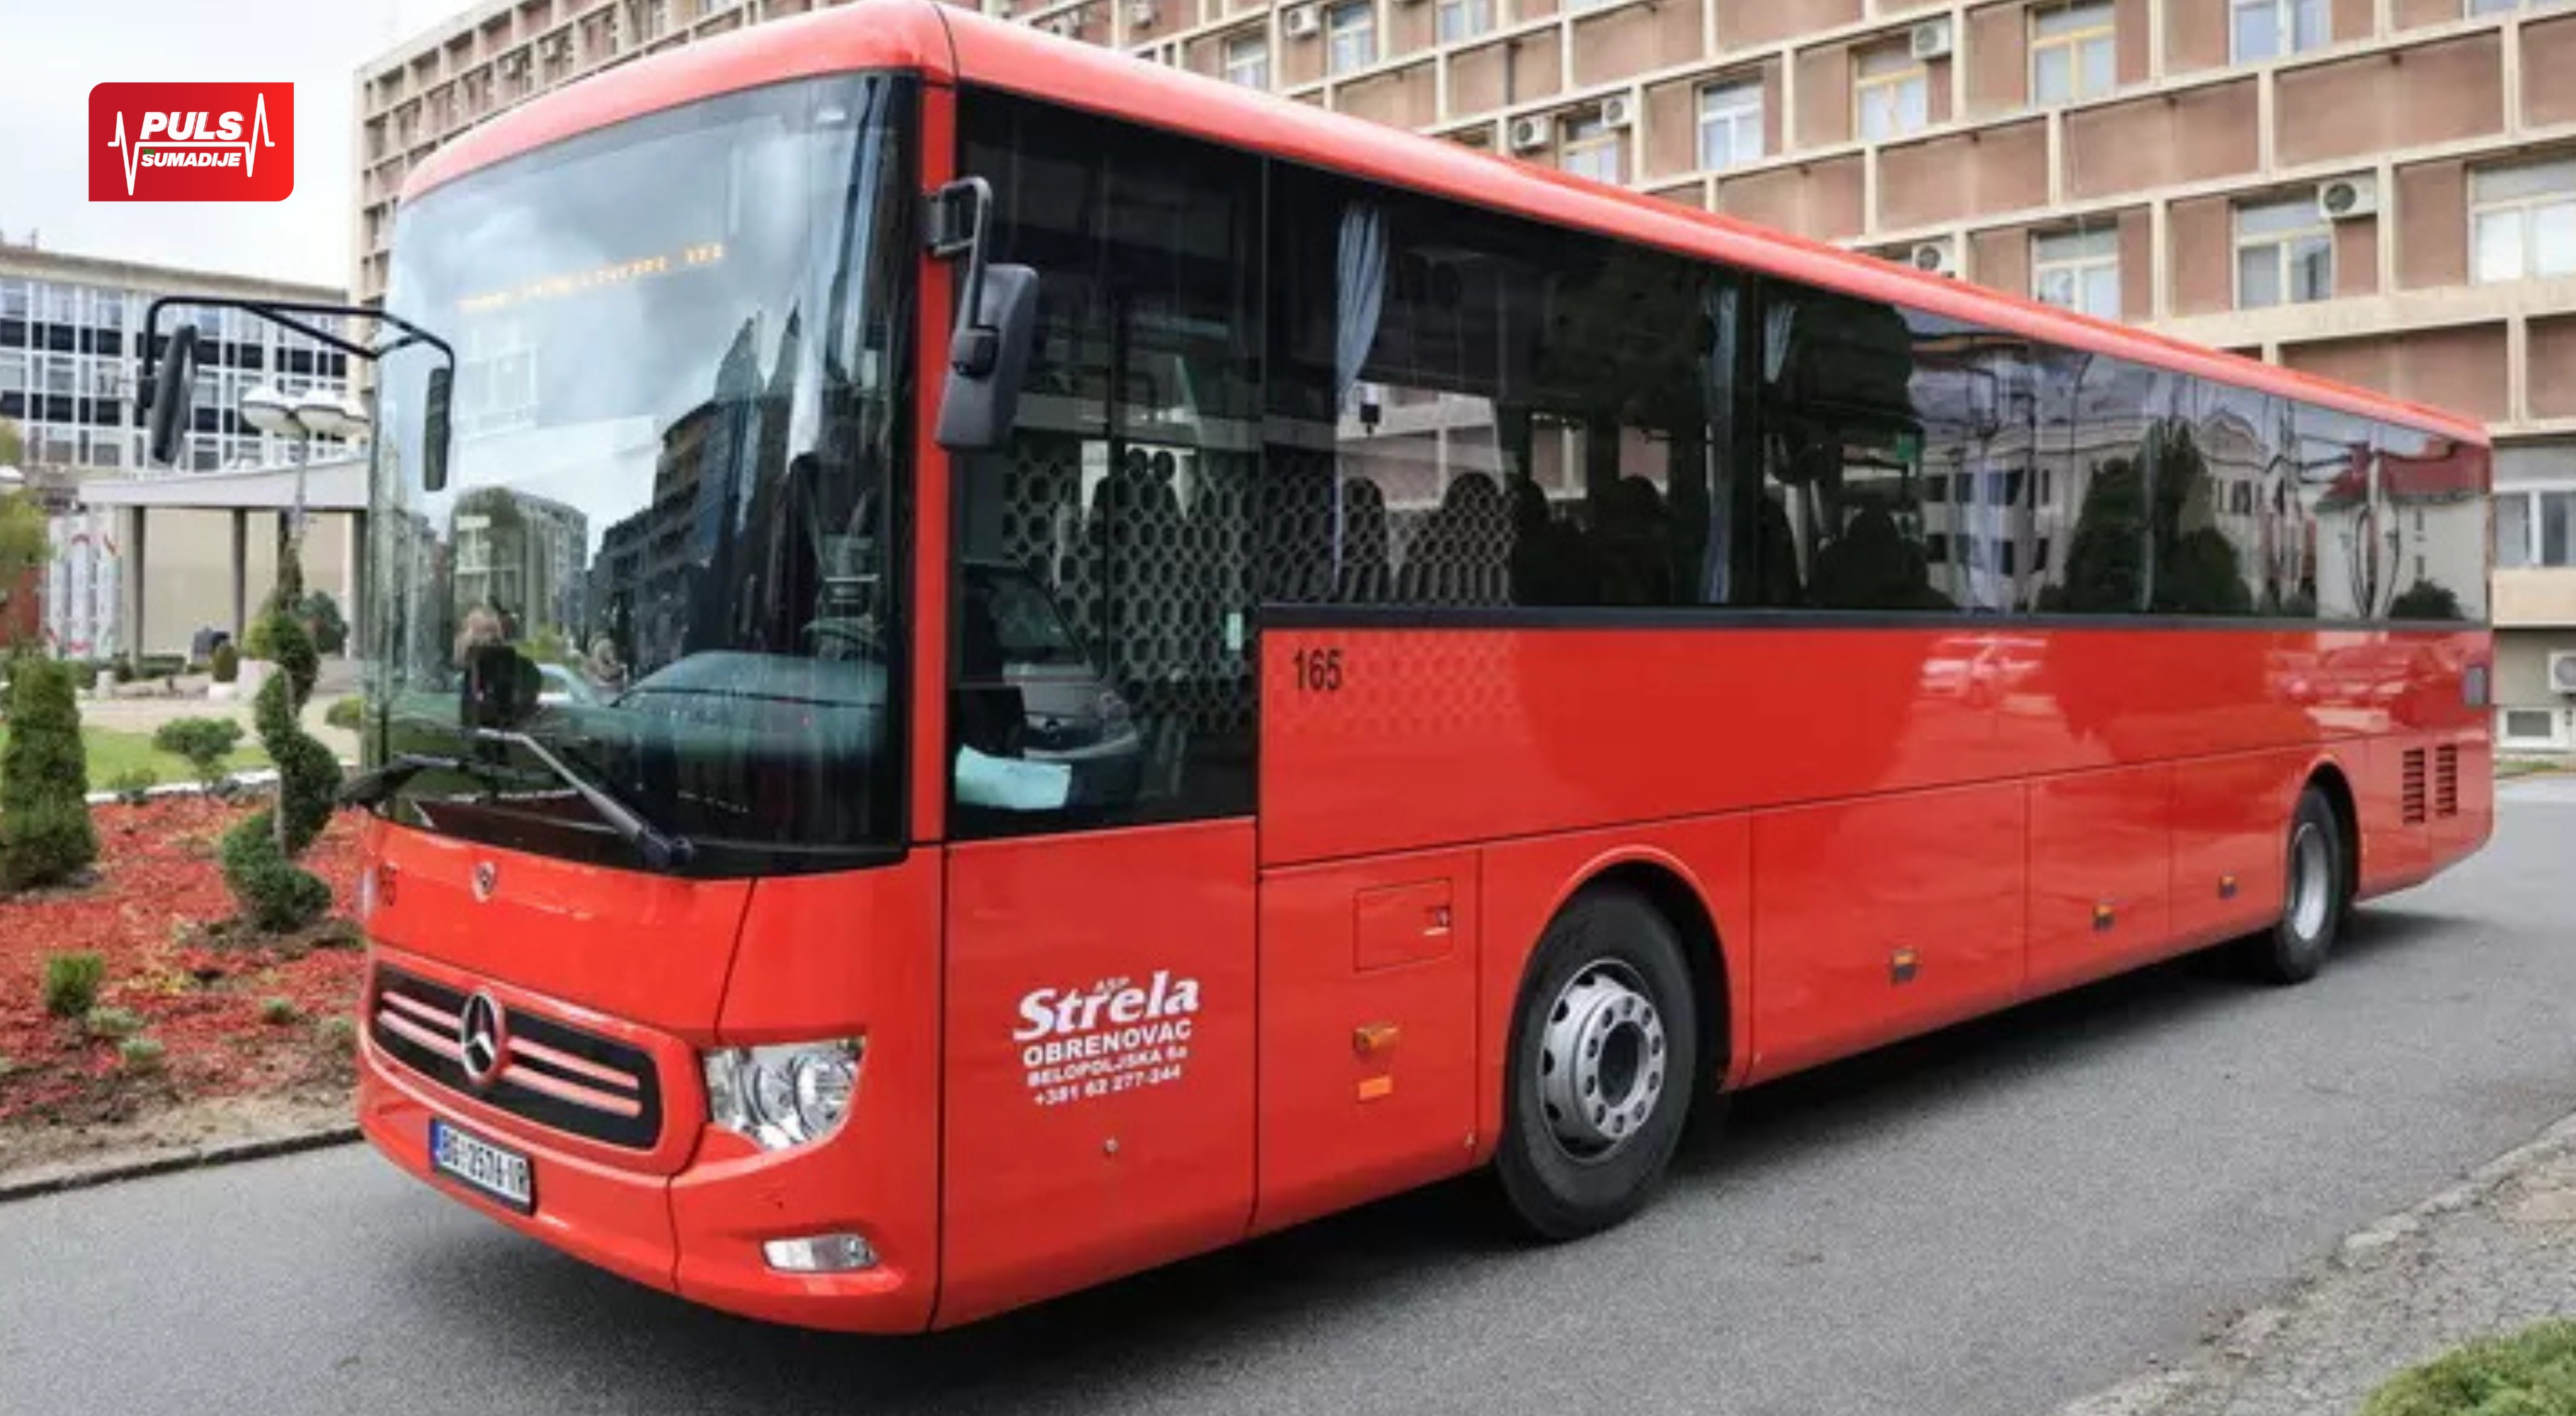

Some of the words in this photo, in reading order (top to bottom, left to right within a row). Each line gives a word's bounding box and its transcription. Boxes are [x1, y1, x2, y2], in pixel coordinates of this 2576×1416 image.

[1292, 646, 1343, 690] 165
[1013, 969, 1199, 1041] Strela
[1023, 1018, 1192, 1067] OBRENOVAC
